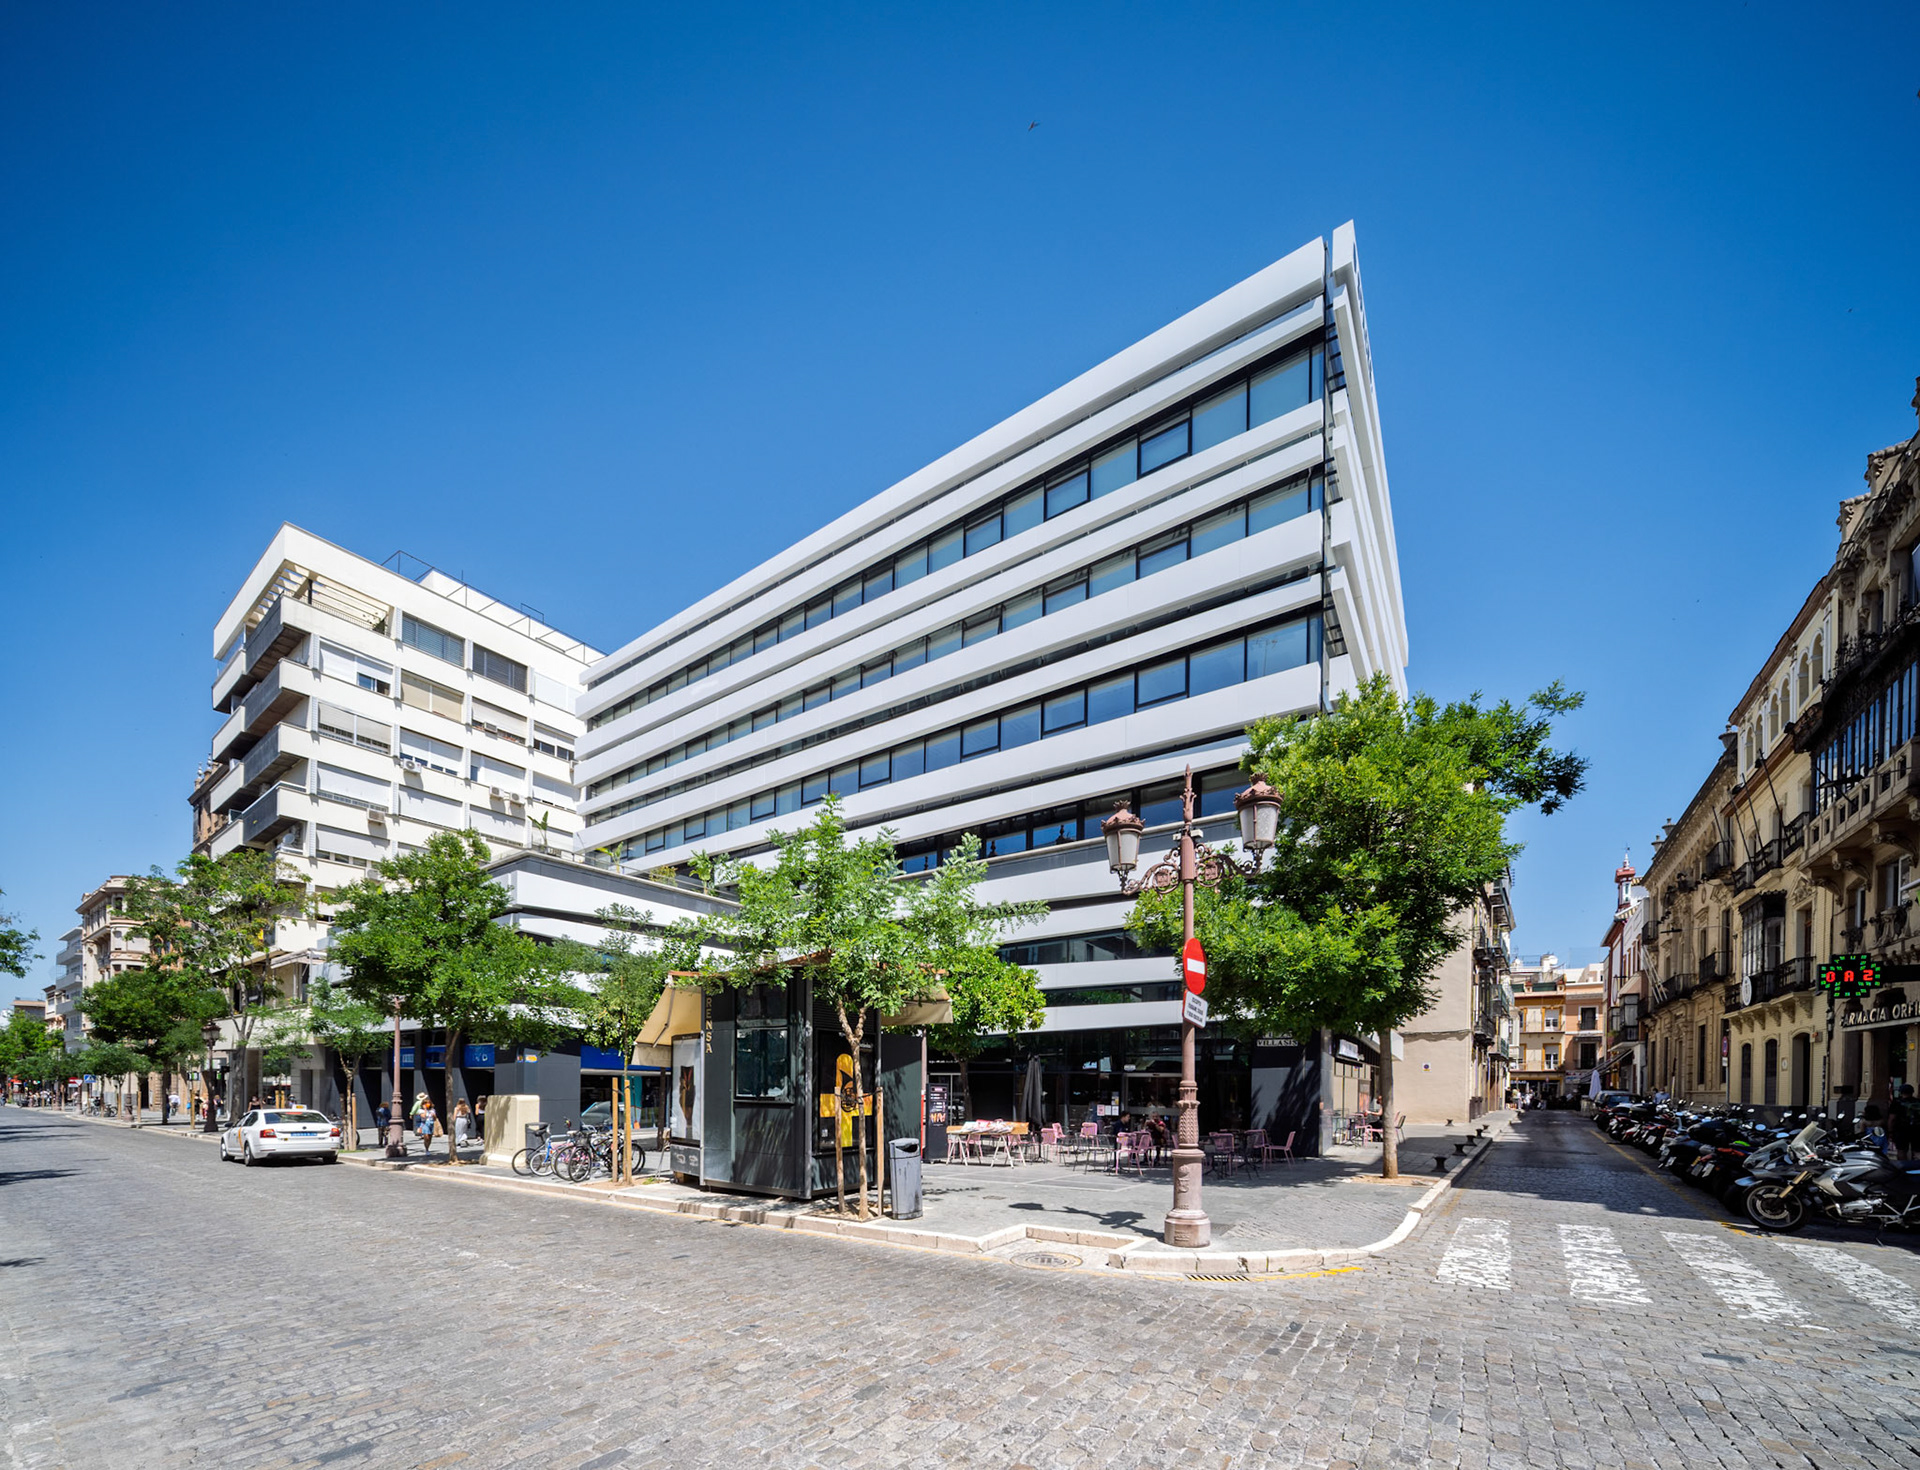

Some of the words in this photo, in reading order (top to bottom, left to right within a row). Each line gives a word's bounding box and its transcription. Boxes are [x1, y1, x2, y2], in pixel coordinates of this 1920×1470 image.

[705, 997, 713, 1054] RENSA
[1840, 1007, 1887, 1026] FARMACIA
[1892, 1001, 1920, 1019] ORFI
